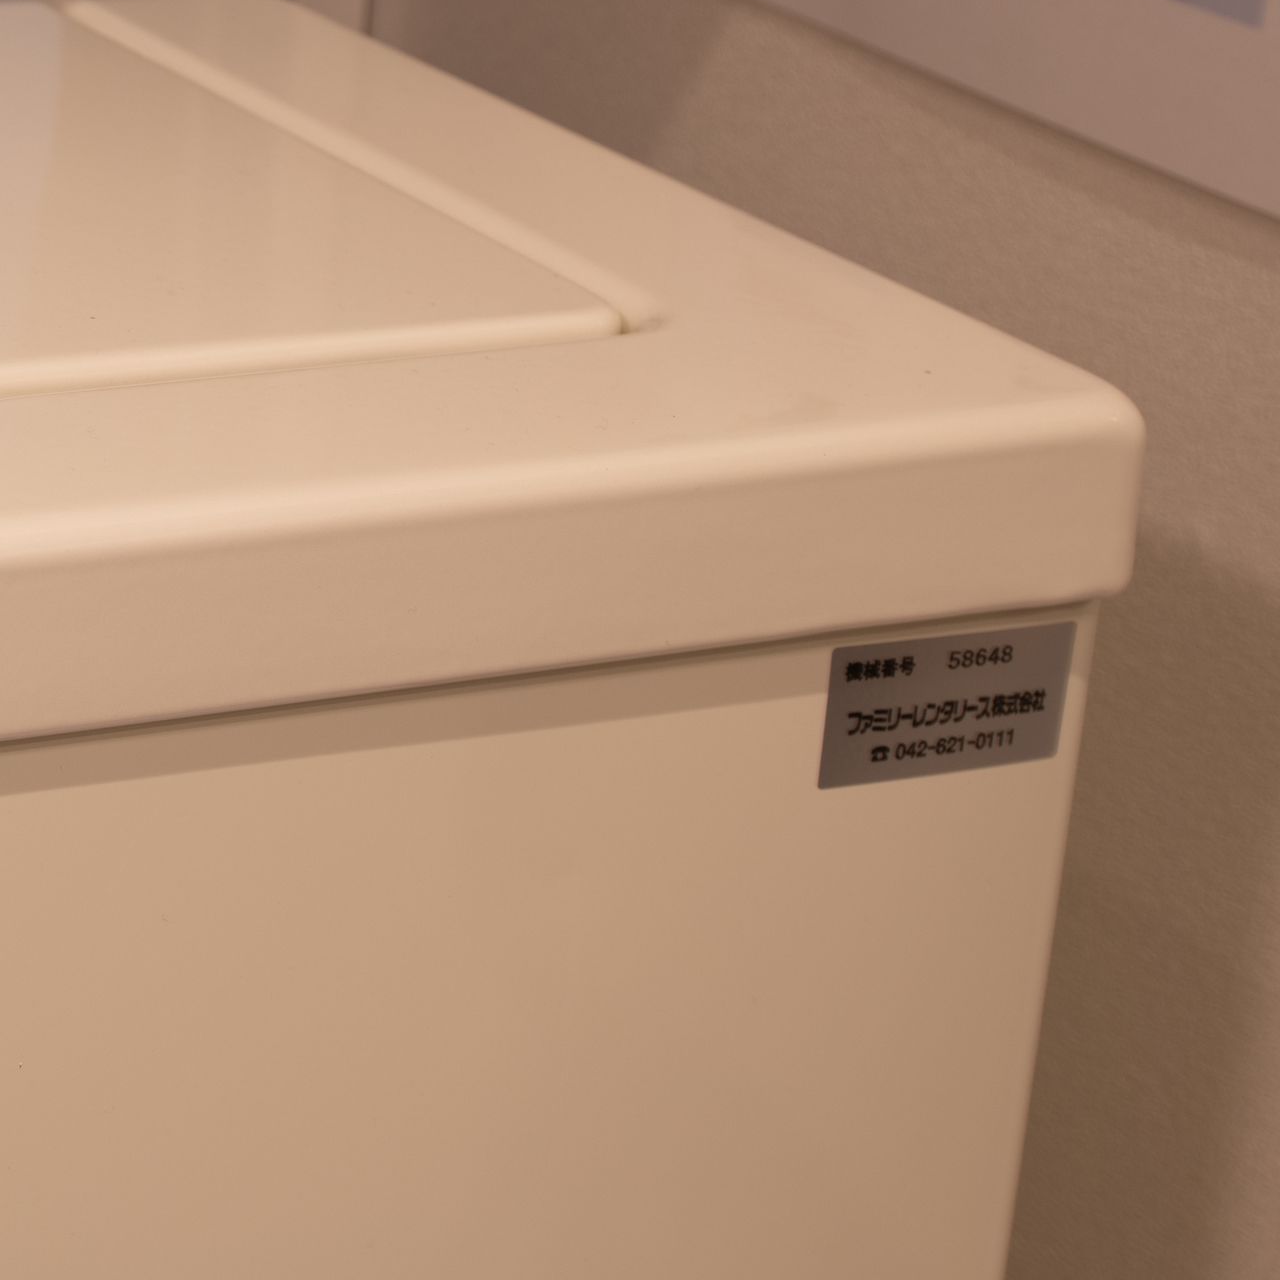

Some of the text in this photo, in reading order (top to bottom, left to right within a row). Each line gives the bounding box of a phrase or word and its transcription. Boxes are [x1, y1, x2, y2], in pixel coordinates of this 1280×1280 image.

[844, 645, 1014, 682] 機械番号 58648
[846, 688, 1047, 736] ファミリーレンタリース株式会社
[894, 729, 1015, 761] 042-621-0111
